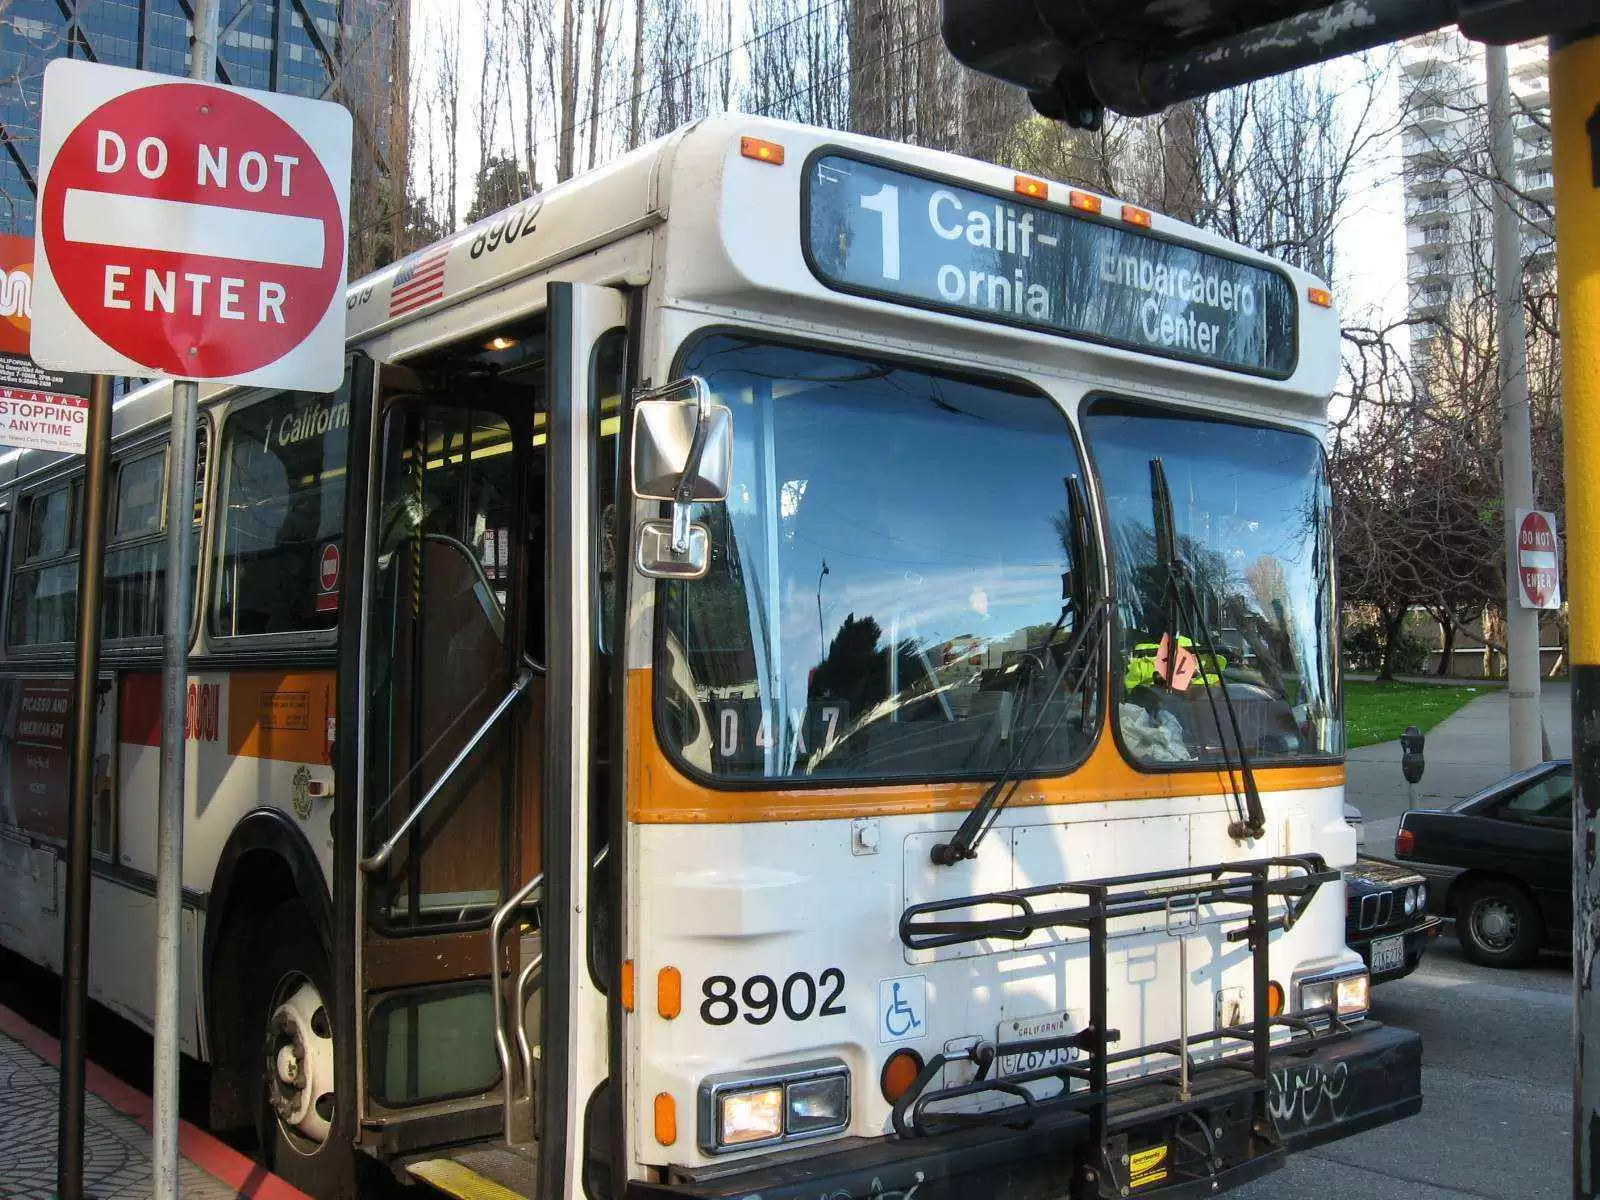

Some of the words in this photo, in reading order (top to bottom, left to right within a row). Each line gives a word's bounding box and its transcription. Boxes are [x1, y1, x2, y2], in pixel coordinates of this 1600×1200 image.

[97, 130, 168, 179] DO
[197, 144, 299, 197] NOT
[470, 199, 544, 259] 8902
[860, 184, 900, 281] 1
[104, 265, 286, 324] ENTER
[936, 264, 1050, 320] ornia
[1102, 244, 1255, 317] Embarcadero
[1141, 301, 1219, 354] Center
[0, 357, 32, 367] ALIFORNIA
[0, 401, 84, 424] STOPPING
[3, 389, 82, 407] W-AWAY
[9, 419, 72, 436] ANYTIME
[1522, 531, 1533, 545] DO
[1535, 532, 1550, 546] NOT
[1526, 573, 1551, 588] ENTER
[700, 967, 847, 1026] 8902
[1019, 1020, 1064, 1037] CALIFORNIA
